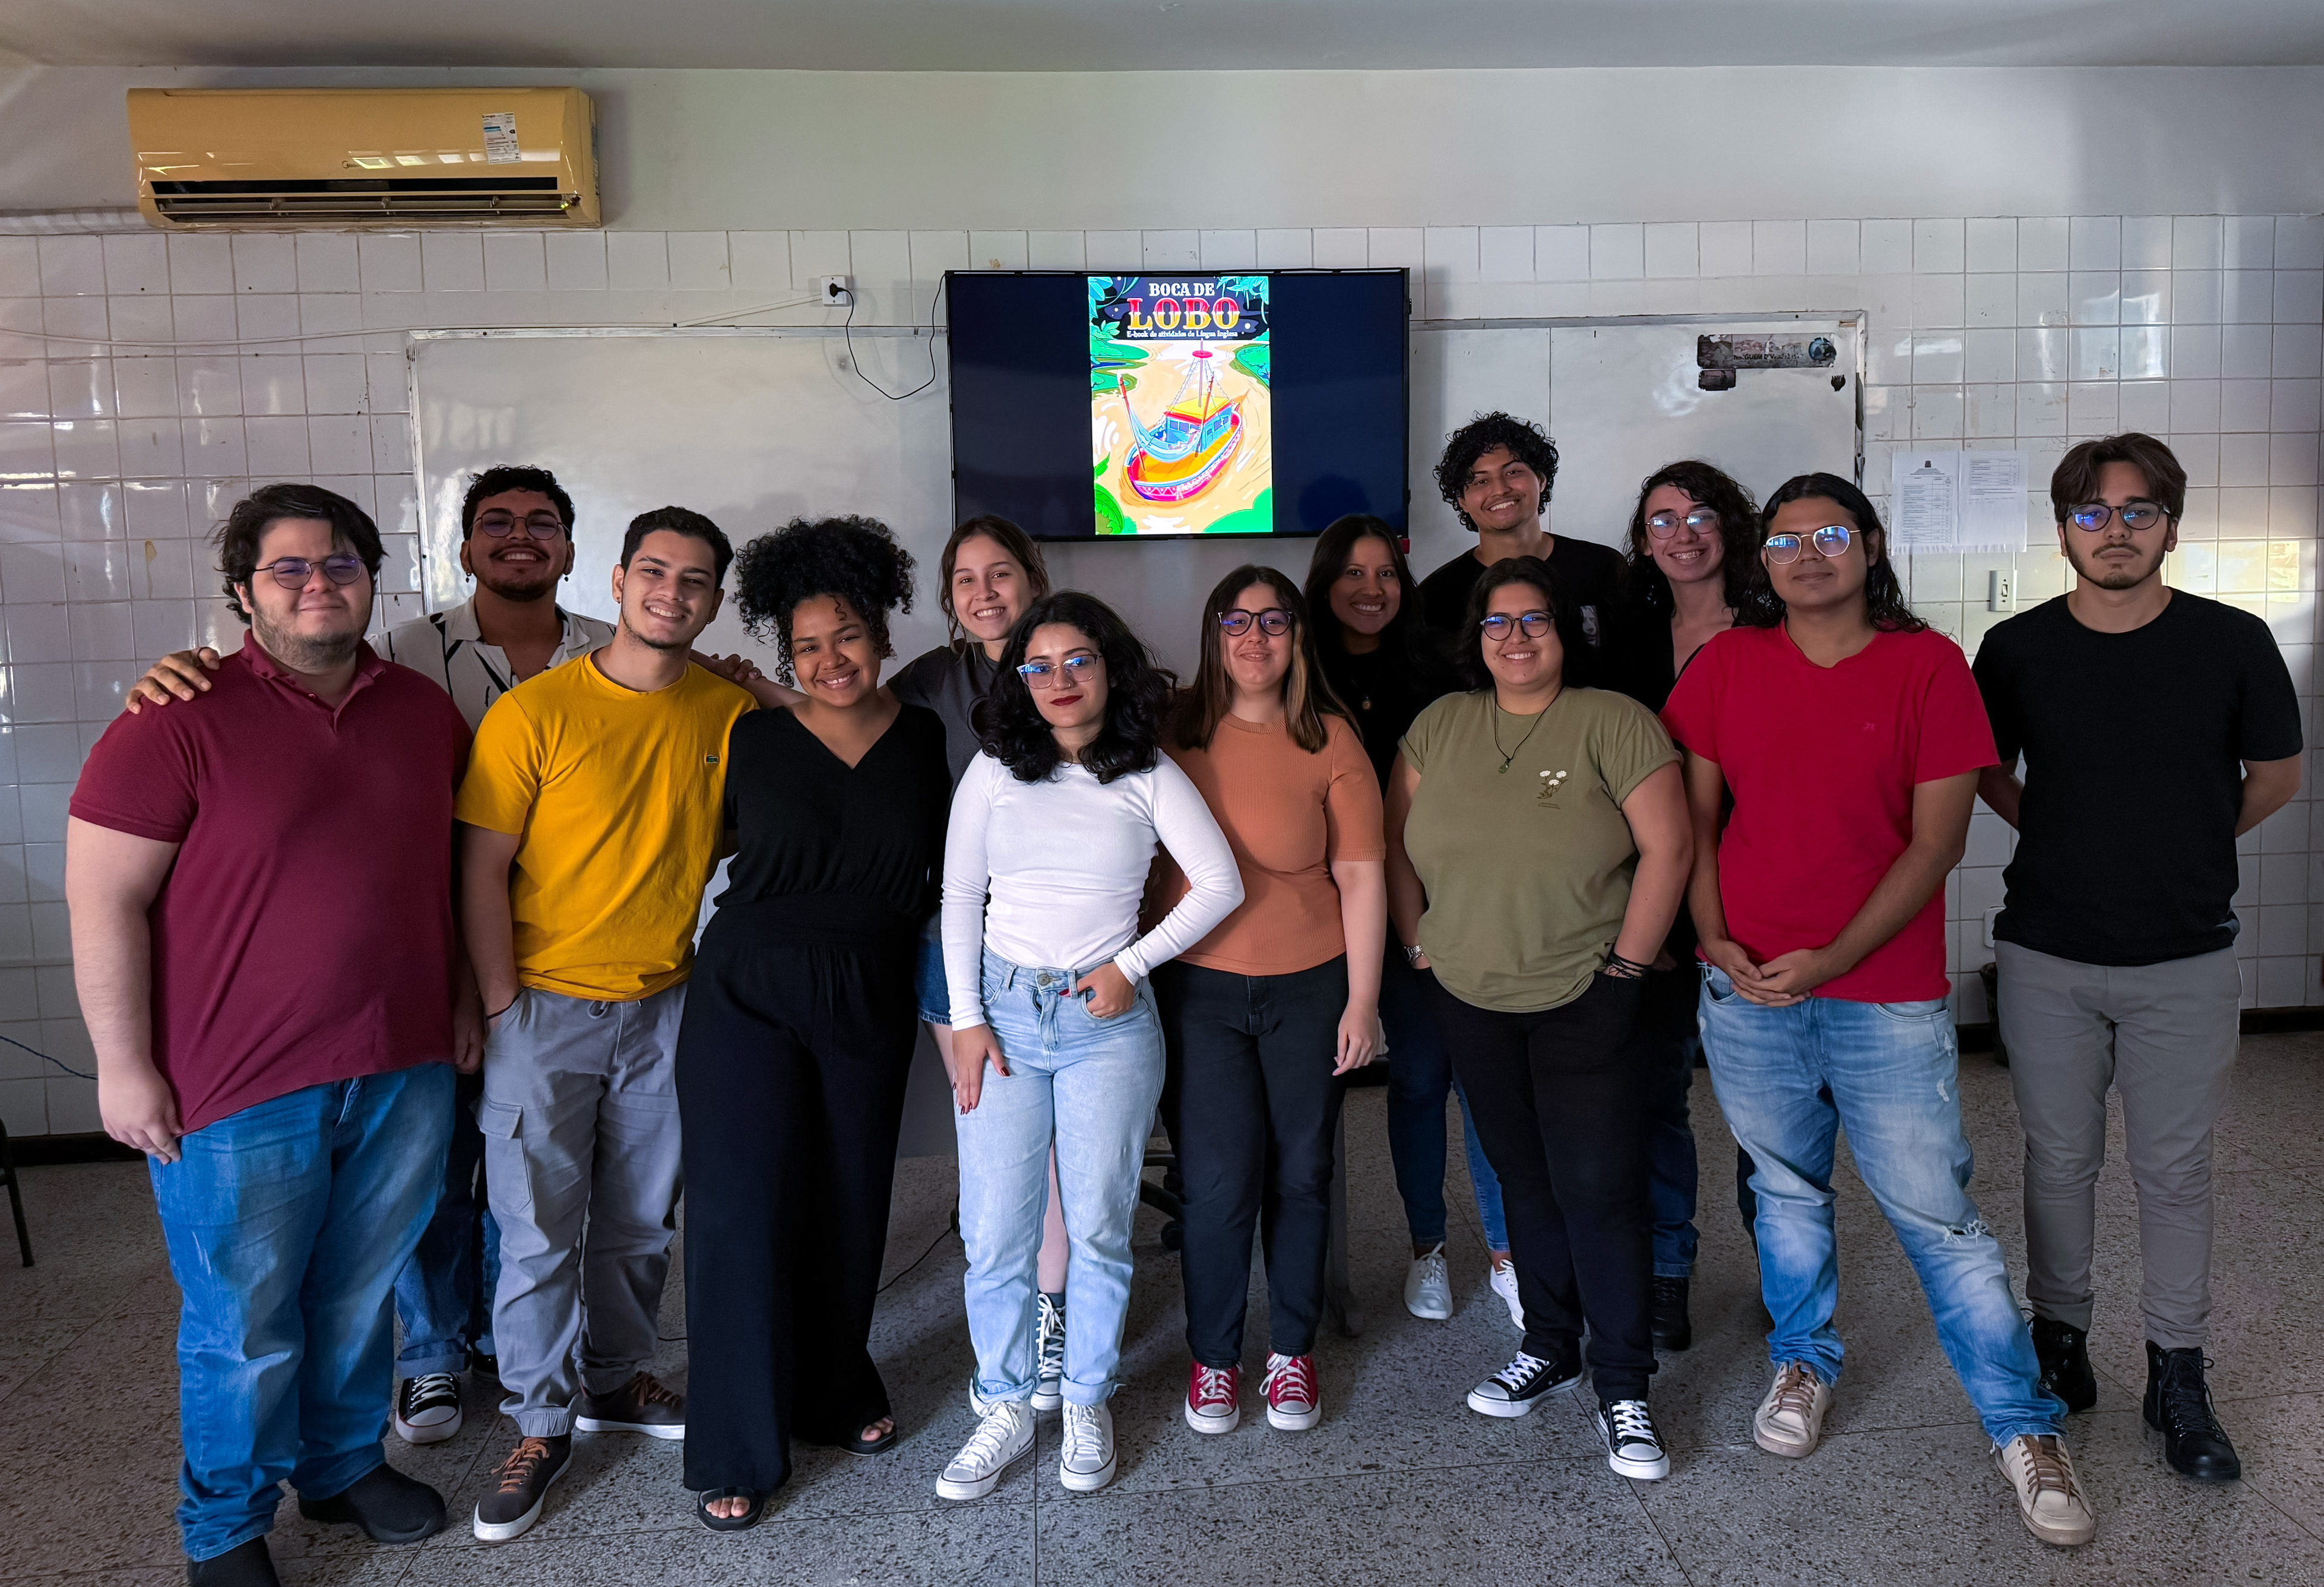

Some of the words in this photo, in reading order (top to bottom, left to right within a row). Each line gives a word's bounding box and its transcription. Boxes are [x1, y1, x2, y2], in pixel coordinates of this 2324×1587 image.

[1148, 283, 1192, 296] BOCA
[1193, 283, 1215, 296] DE
[1126, 297, 1240, 330] LOBO
[1217, 330, 1239, 338] Inglesa
